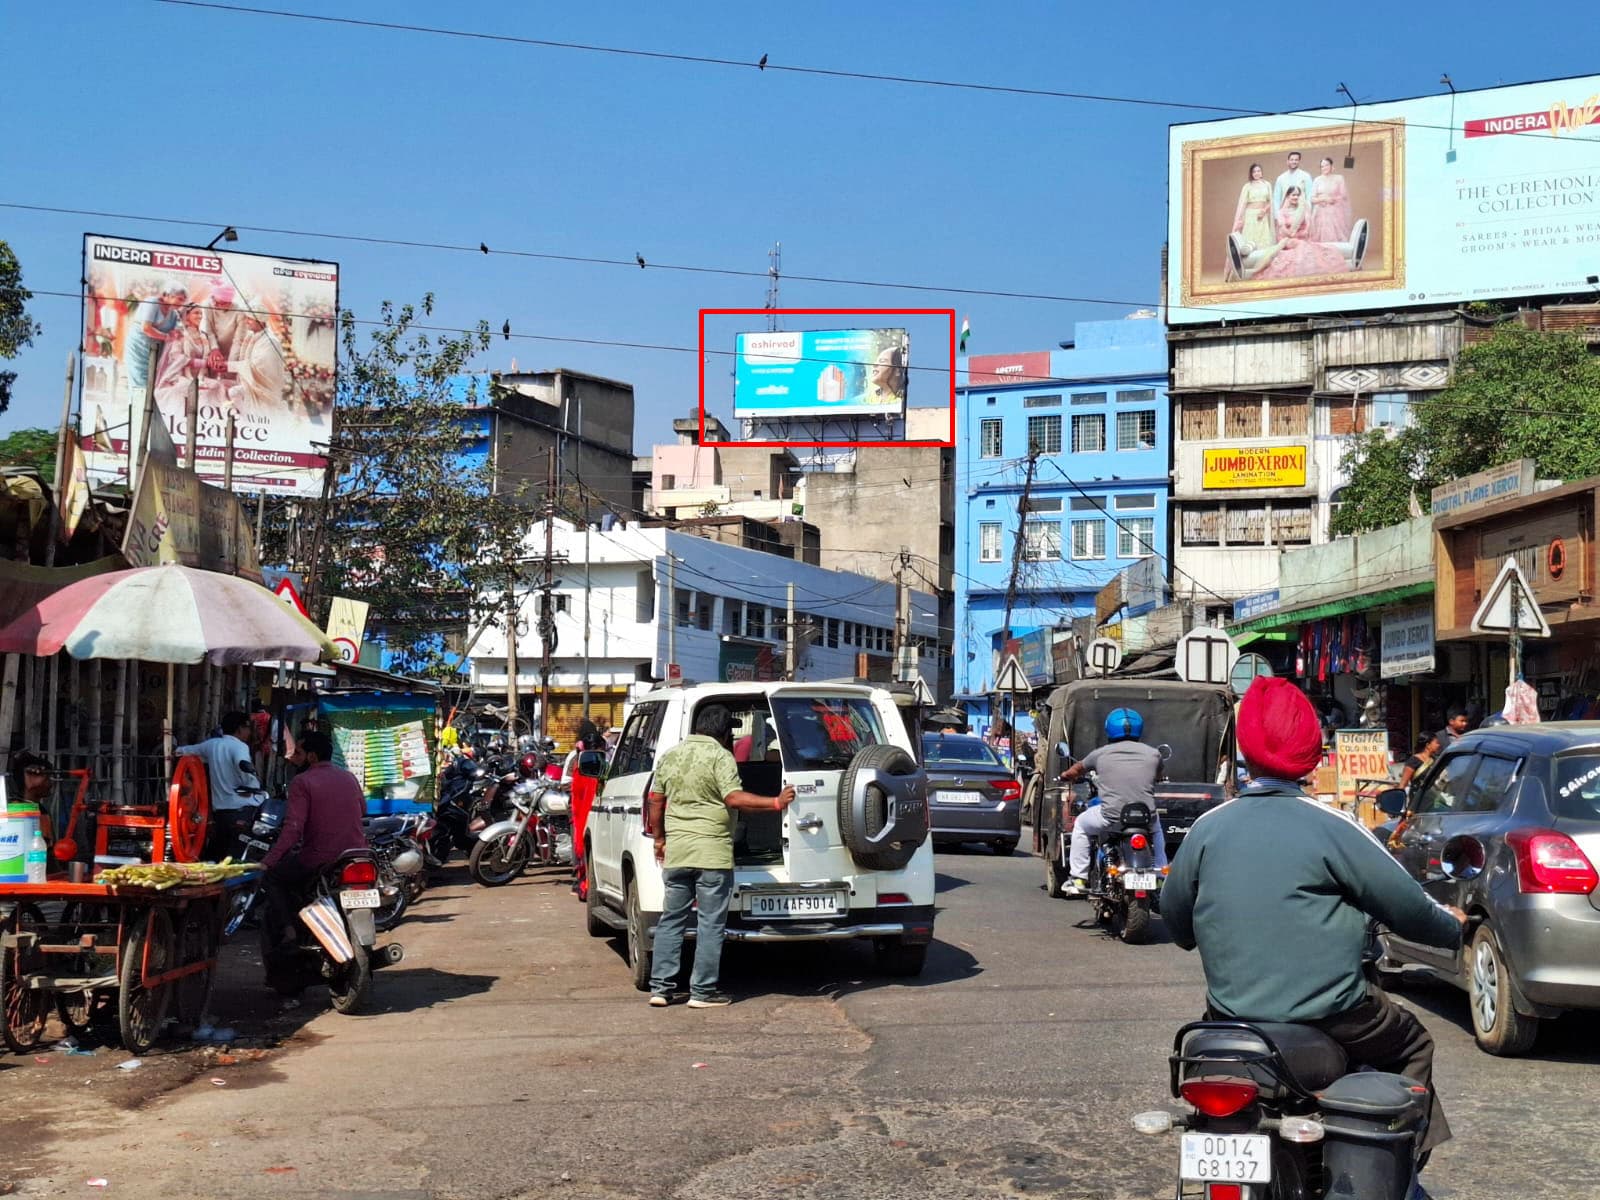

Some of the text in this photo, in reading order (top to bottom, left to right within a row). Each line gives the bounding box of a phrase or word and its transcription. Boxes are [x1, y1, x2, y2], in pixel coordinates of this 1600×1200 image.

[1484, 114, 1548, 132] INDERA
[1456, 186, 1490, 200] THE
[1478, 190, 1594, 214] COLLECTION
[1462, 230, 1508, 242] SAREES
[1523, 225, 1569, 237] BRIDAL
[95, 245, 221, 271] INDERA TEXTILES
[247, 413, 271, 425] With
[235, 450, 296, 464] Collection.
[1232, 471, 1276, 479] LAMINATION
[1432, 494, 1462, 513] DIGITAL
[1463, 484, 1490, 504] PLANE
[1491, 474, 1520, 496] XEROX
[1342, 732, 1385, 744] DIGITAL
[1340, 754, 1386, 775] XEROX
[1204, 1137, 1253, 1157] OD14
[1197, 1159, 1259, 1179] G8137
